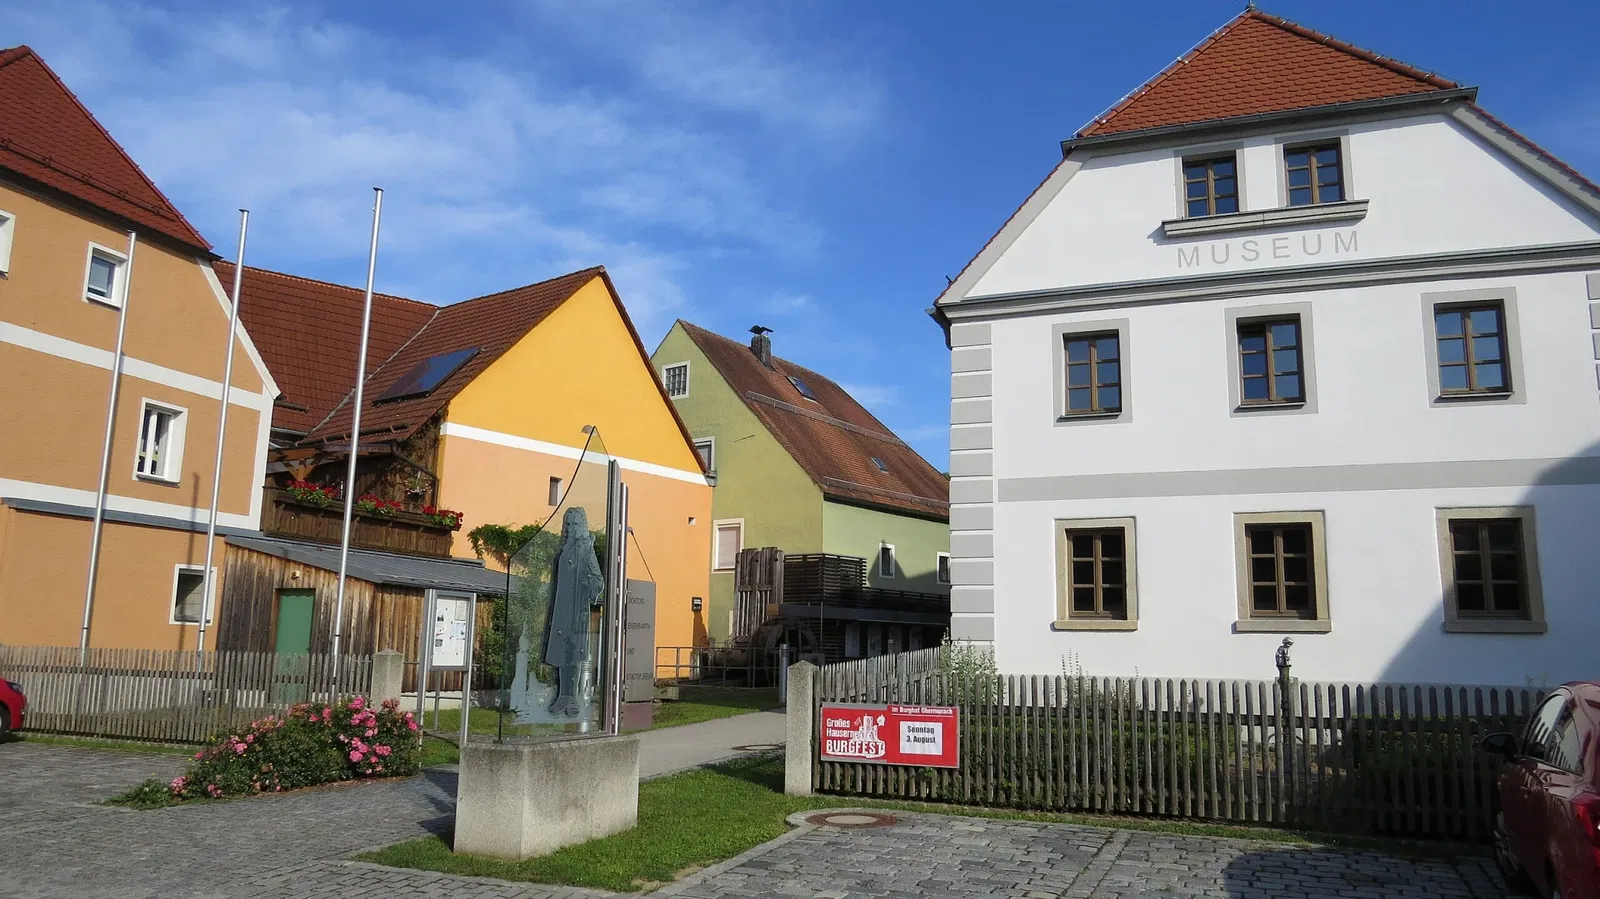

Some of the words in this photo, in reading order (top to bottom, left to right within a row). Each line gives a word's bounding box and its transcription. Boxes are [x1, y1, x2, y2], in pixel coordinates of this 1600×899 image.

[1177, 230, 1358, 269] MUSEUM
[900, 706, 920, 714] Burghof
[826, 717, 851, 728] Großes
[907, 725, 935, 735] Sonntag
[906, 735, 912, 743] 3.
[913, 735, 936, 744] August
[826, 740, 884, 755] BURGFEST
